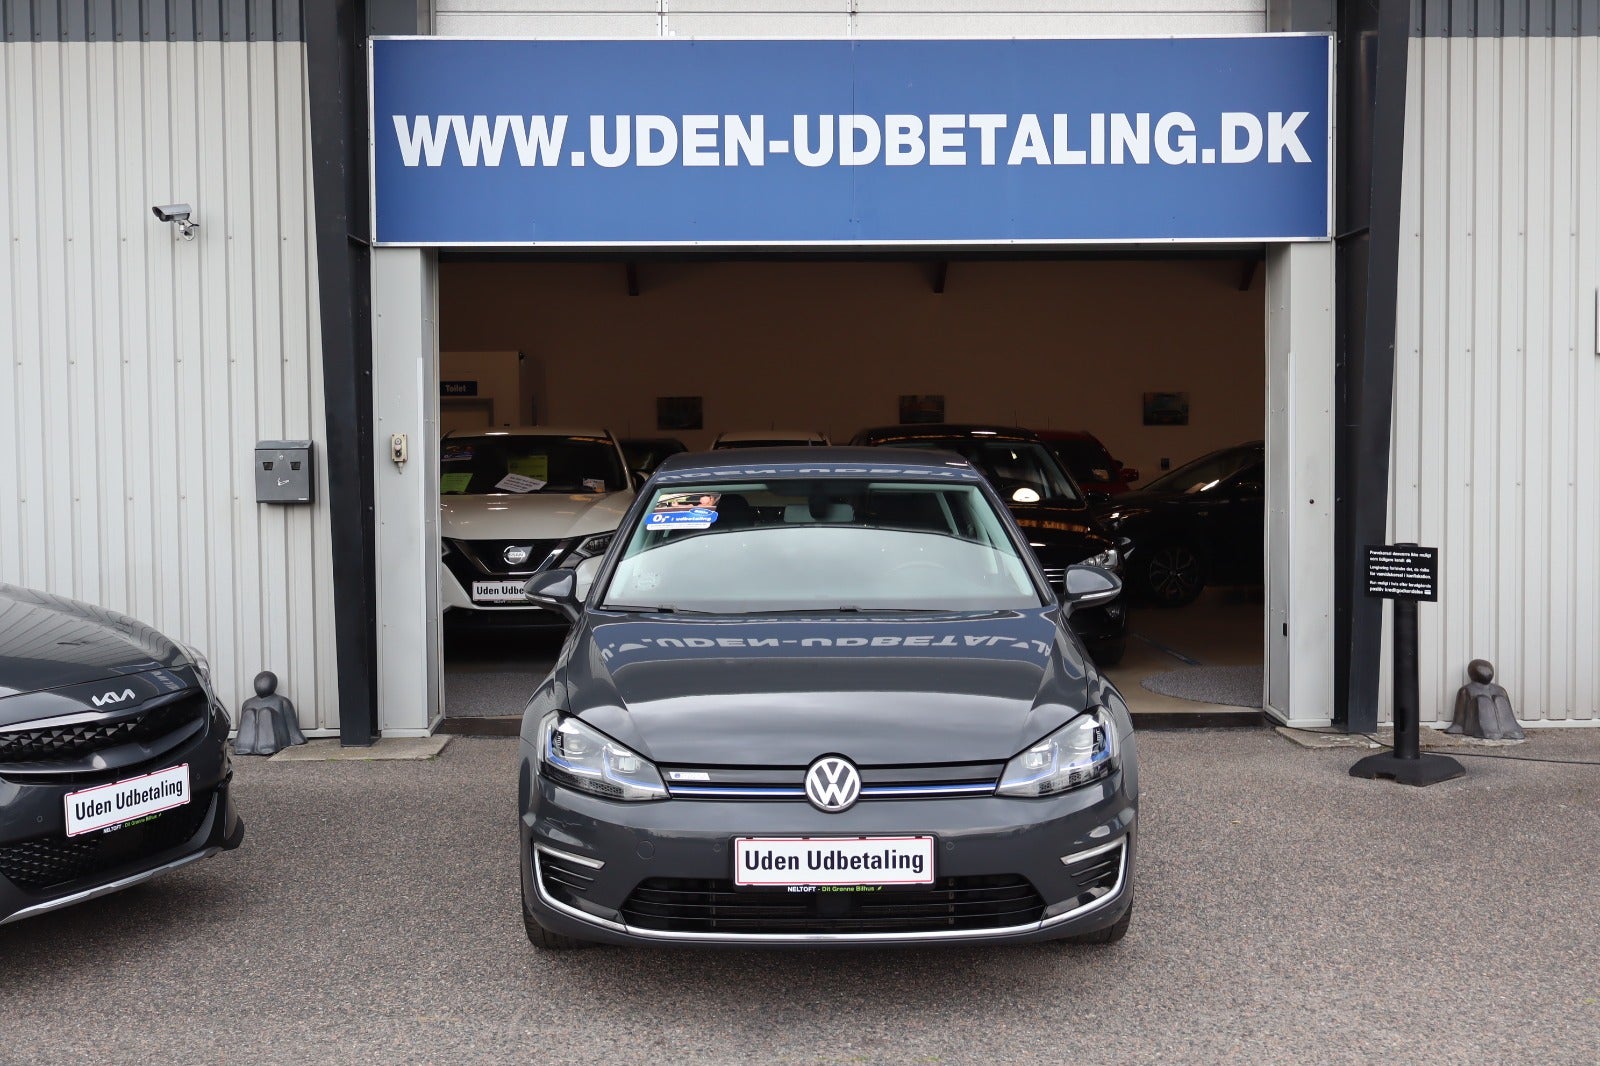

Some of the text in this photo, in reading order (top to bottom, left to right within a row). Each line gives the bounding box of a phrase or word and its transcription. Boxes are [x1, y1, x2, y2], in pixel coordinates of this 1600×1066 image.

[393, 111, 1312, 168] WWW.UDEN-UDBETALING.DK
[445, 384, 466, 393] Toilet
[476, 586, 499, 595] Uden
[75, 780, 183, 821] Uden Udbetaling
[745, 849, 924, 874] Uden Udbetaling
